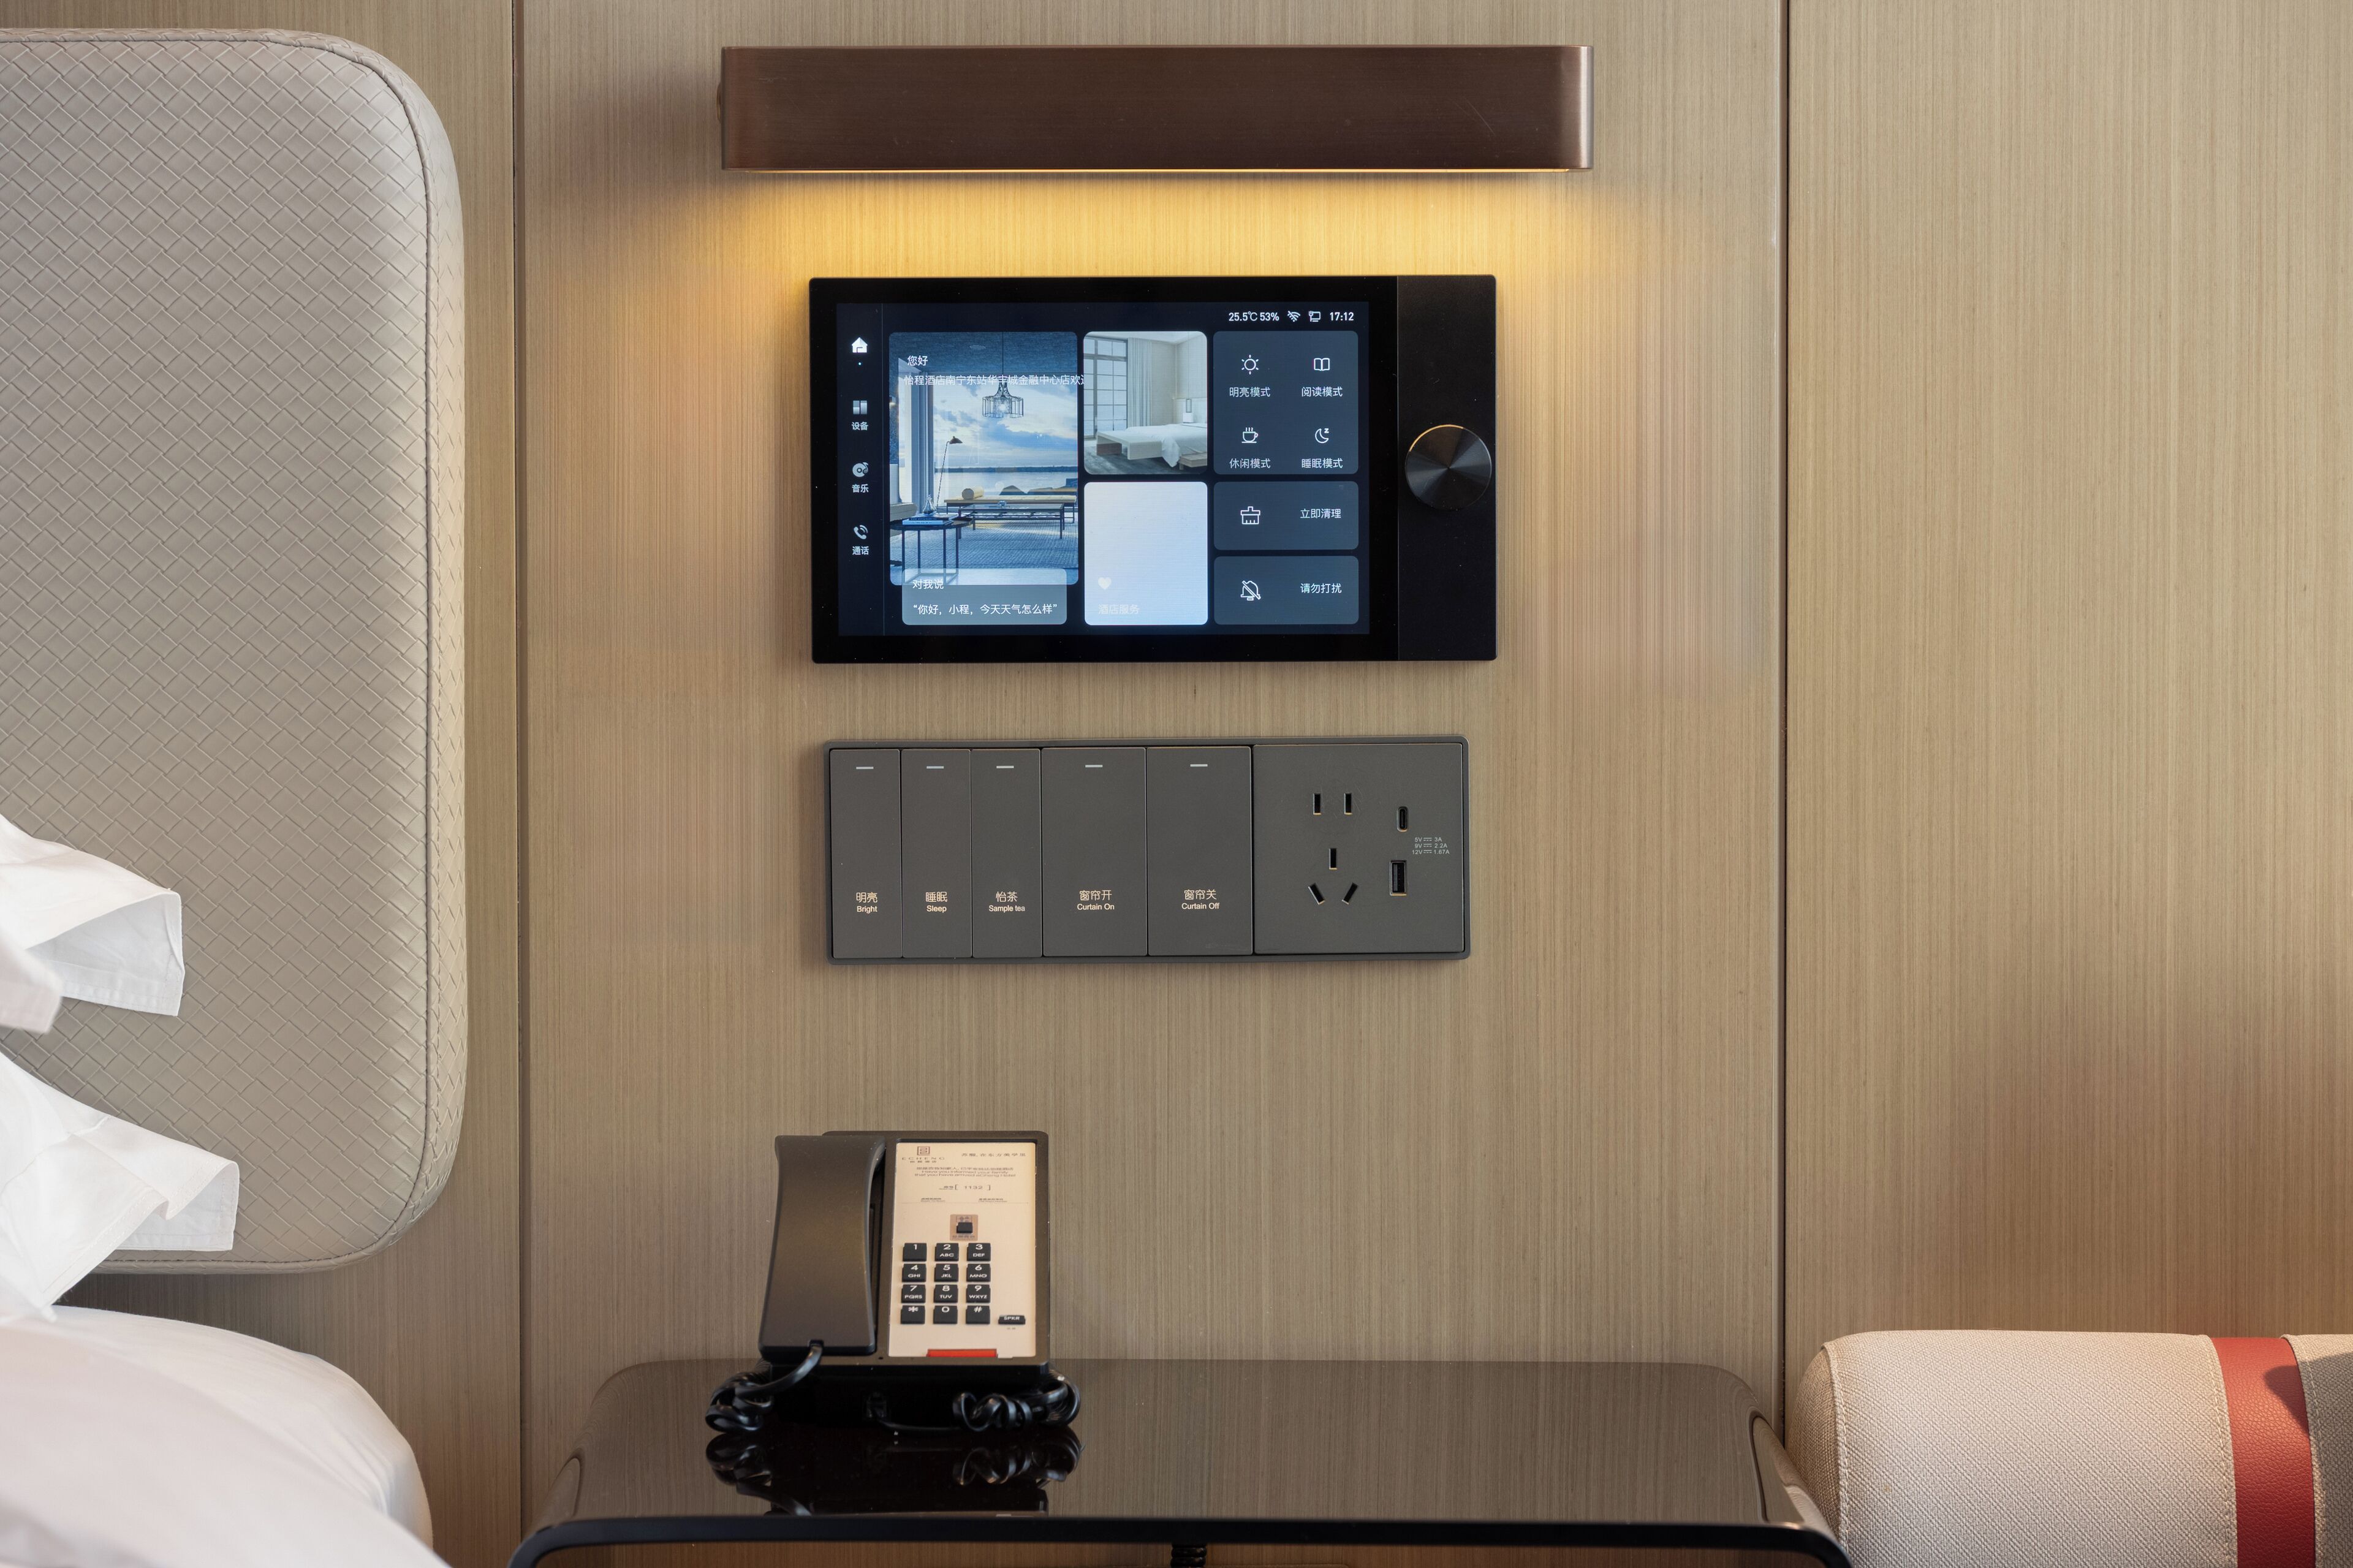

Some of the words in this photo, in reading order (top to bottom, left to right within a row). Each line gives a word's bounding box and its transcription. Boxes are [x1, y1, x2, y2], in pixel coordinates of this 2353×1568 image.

[1260, 312, 1279, 321] 53%
[1330, 311, 1354, 321] 17:12
[907, 355, 928, 366] 您好
[1229, 386, 1271, 398] 明亮模式
[1302, 386, 1343, 397] 阅读模式
[851, 421, 869, 431] 设备
[1229, 458, 1271, 469] 休闲模式
[1302, 458, 1343, 469] 睡眠模式
[851, 483, 869, 493] 音乐
[1300, 508, 1341, 519] 立即清理
[852, 545, 870, 555] 通话
[912, 579, 944, 589] 对我说
[1300, 583, 1342, 594] 请勿打扰
[1098, 604, 1140, 615] 酒店服务
[856, 892, 878, 903] 明亮
[925, 891, 948, 903] 睡眠
[995, 891, 1018, 903] 怡茶
[1079, 890, 1112, 901] 窗帘开
[1184, 889, 1217, 900] 窗帘关
